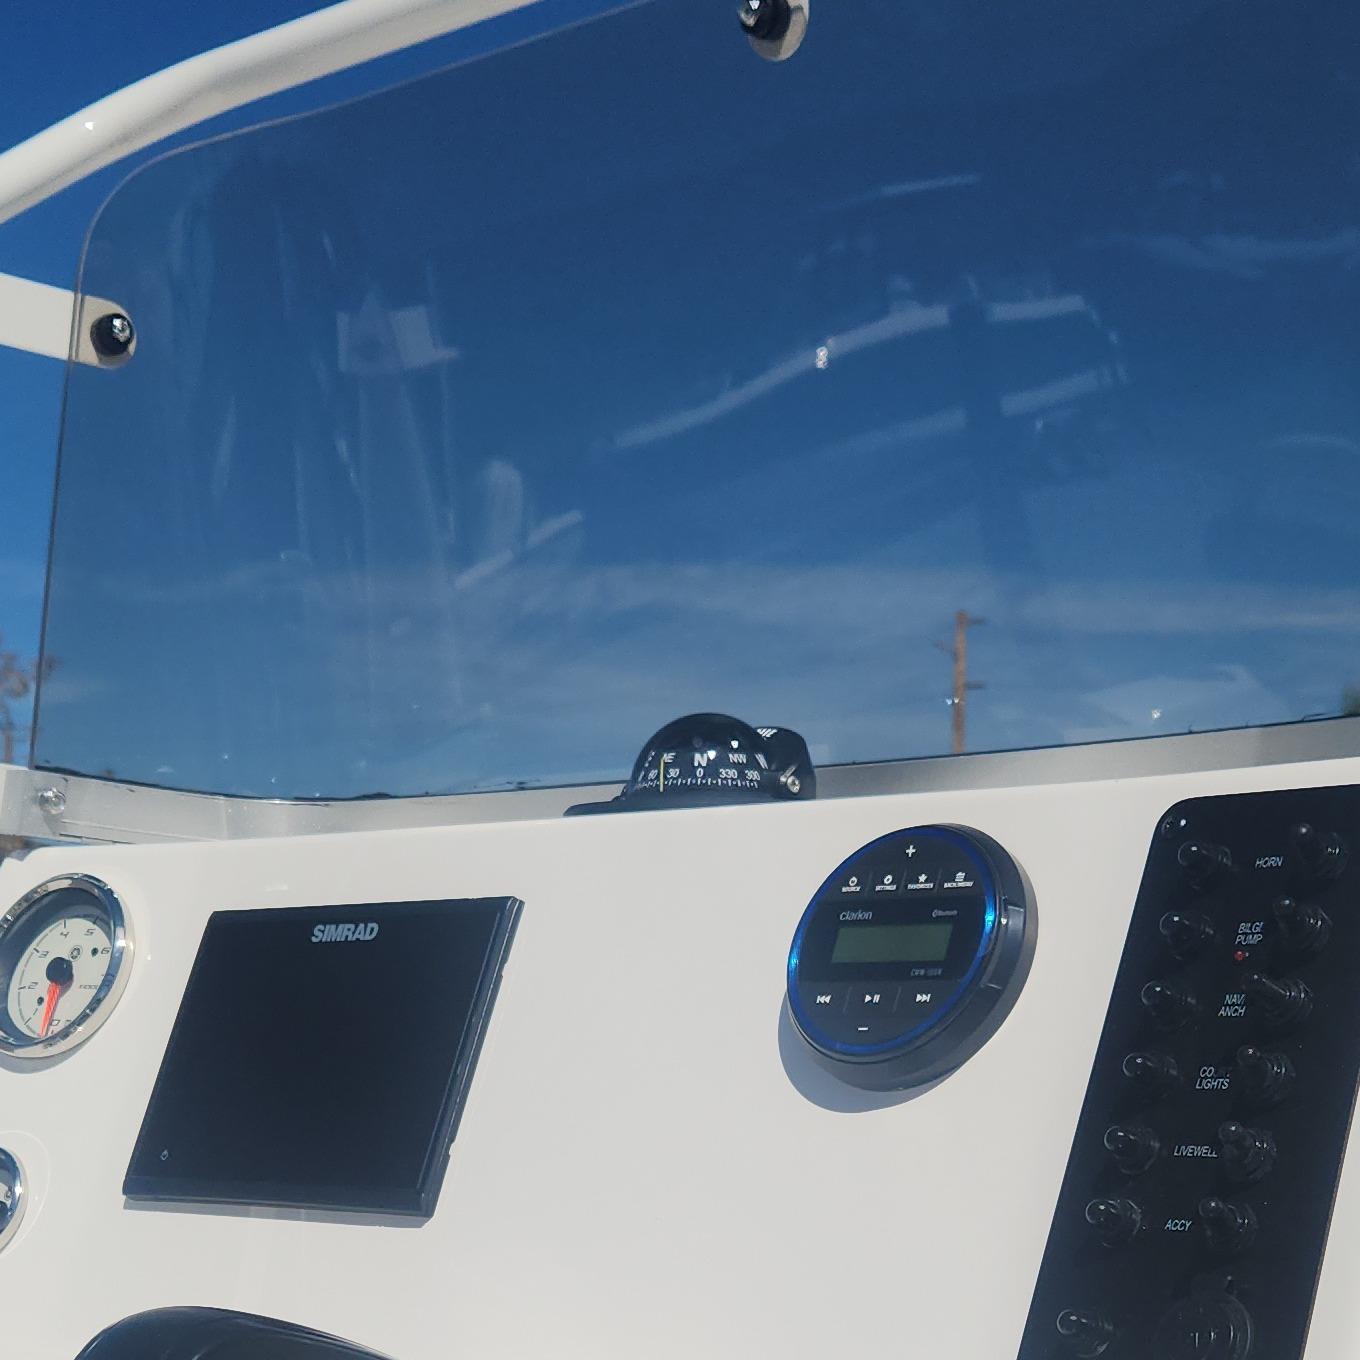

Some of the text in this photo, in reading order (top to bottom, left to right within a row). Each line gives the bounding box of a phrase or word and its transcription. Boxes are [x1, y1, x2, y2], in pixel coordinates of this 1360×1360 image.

[694, 753, 708, 766] N
[729, 754, 746, 764] NW
[668, 768, 680, 778] 30
[720, 768, 738, 779] 330
[746, 769, 760, 780] 300
[1255, 856, 1283, 869] HORN
[311, 922, 380, 943] SIMRAD
[1235, 934, 1264, 946] PUMP
[1218, 1005, 1246, 1018] ANCH
[1196, 1077, 1230, 1090] LIGHTS
[1173, 1145, 1218, 1158] LIVEWELL
[1164, 1220, 1192, 1232] ACCY
